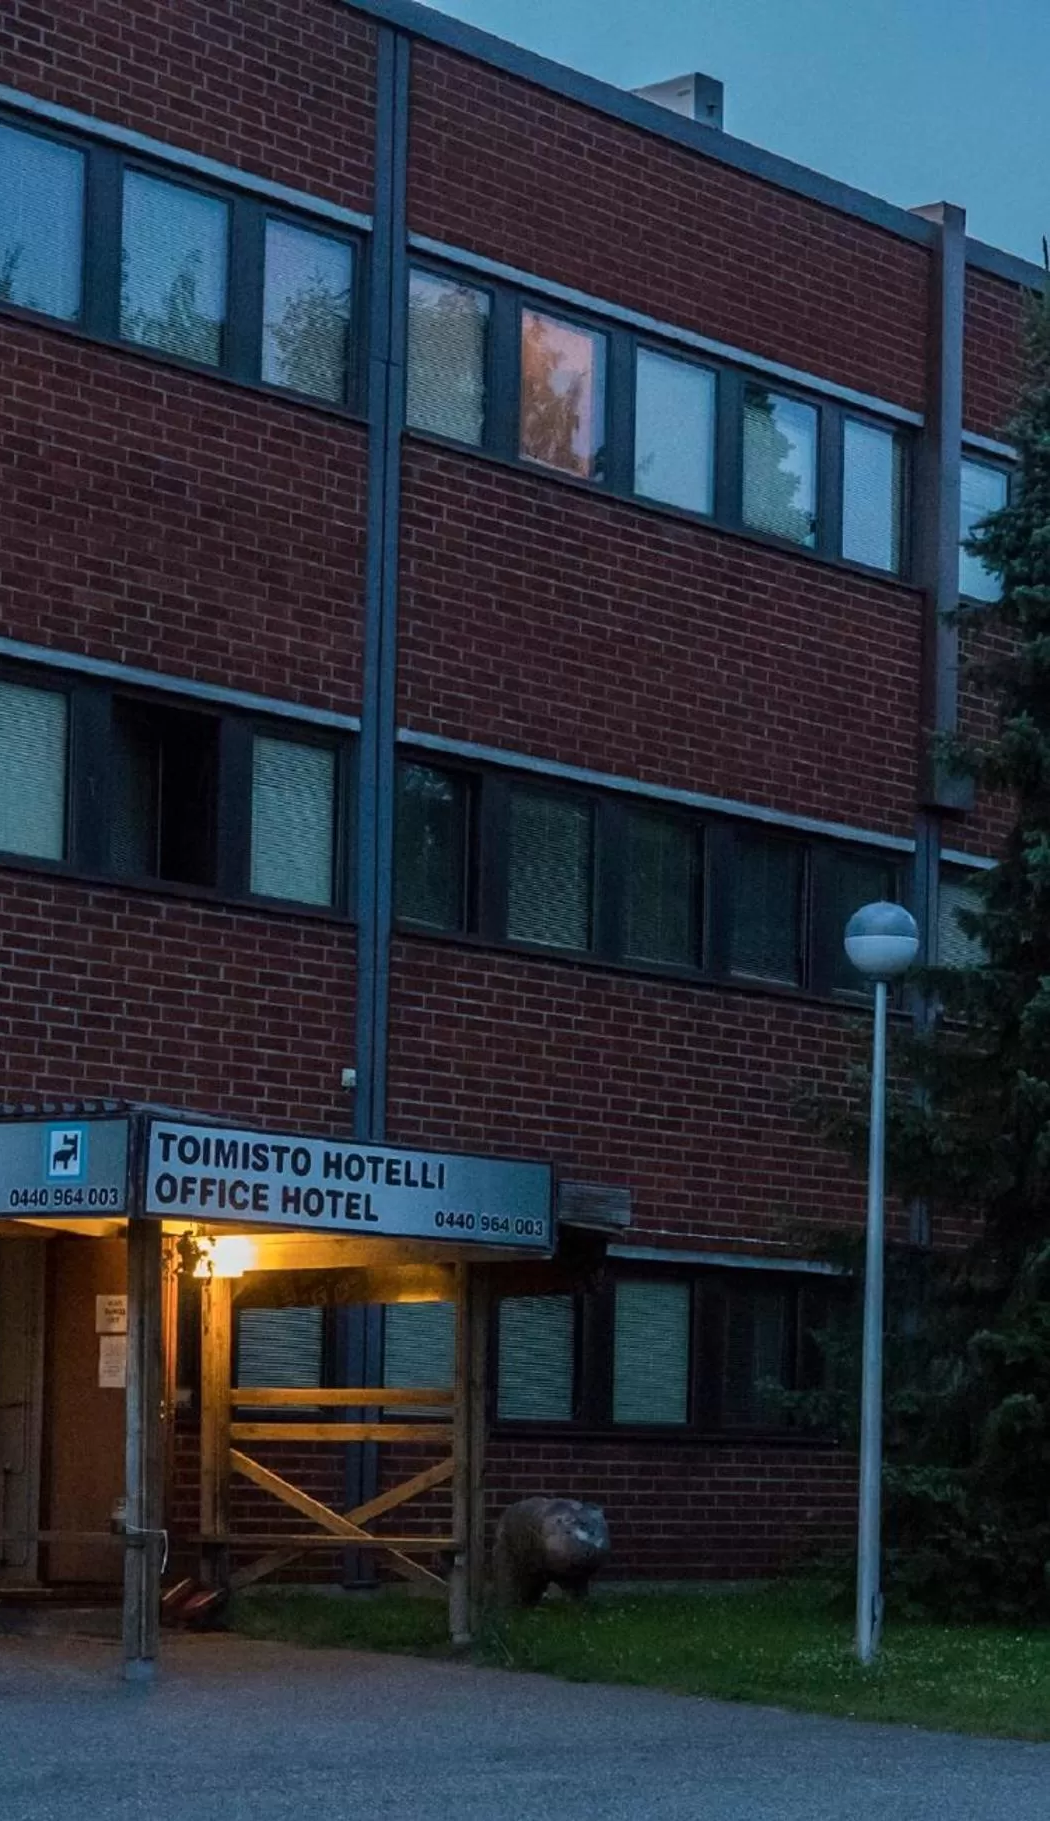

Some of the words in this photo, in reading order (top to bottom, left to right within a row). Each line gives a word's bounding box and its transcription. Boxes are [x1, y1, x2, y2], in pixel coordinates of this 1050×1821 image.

[157, 1132, 312, 1177] TOIMISTO
[323, 1150, 446, 1190] HOTELLI
[9, 1187, 49, 1208] 0440
[53, 1187, 85, 1207] 964
[88, 1186, 119, 1207] 003
[154, 1172, 270, 1213] OFFICE
[281, 1185, 380, 1223] HOTEL
[434, 1209, 476, 1231] 0440
[480, 1214, 511, 1234] 964
[515, 1217, 544, 1238] 003
